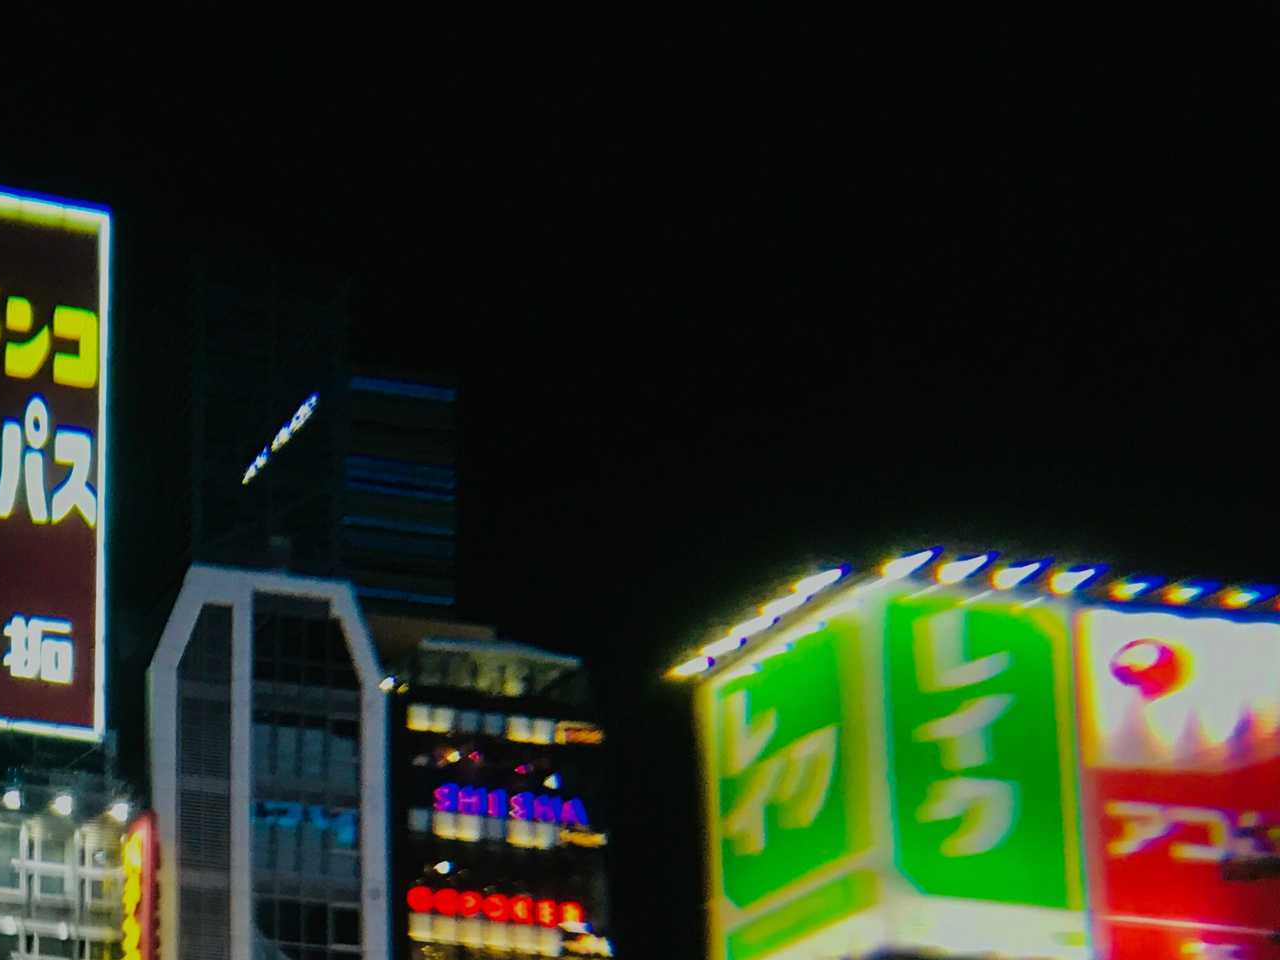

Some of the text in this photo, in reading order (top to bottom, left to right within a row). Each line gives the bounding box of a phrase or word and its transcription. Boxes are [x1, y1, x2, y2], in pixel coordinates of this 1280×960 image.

[434, 782, 589, 826] SHISHA
[720, 685, 839, 858] レイク
[910, 602, 1020, 860] レイク
